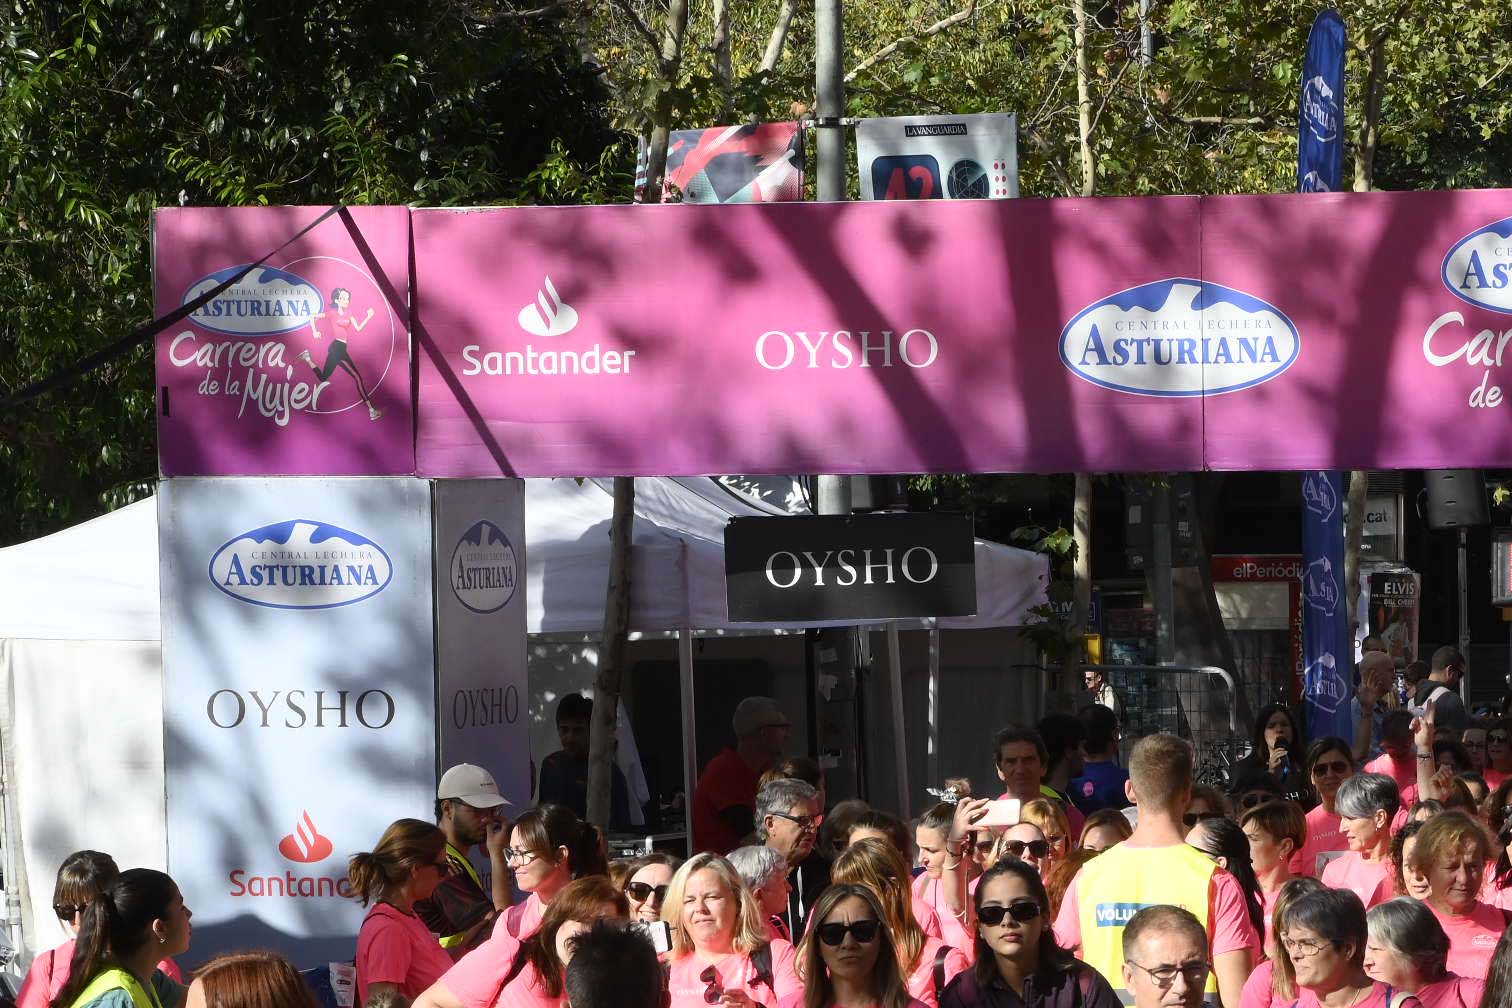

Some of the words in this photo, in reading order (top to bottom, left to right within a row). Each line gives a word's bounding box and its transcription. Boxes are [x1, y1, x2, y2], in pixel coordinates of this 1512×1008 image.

[1115, 320, 1190, 331] CENTRAL
[1197, 319, 1273, 330] LECHERA
[169, 331, 287, 368] Carrera
[462, 344, 636, 377] Santander
[755, 329, 939, 371] OYSHO
[1078, 323, 1281, 366] ASTURIANA
[198, 370, 219, 395] de
[226, 367, 240, 395] la
[238, 365, 331, 426] Mujer
[1469, 369, 1504, 409] de
[224, 553, 379, 587] ASTURIANA
[251, 551, 309, 560] CENTRAL
[315, 551, 373, 560] LECHERA
[456, 554, 514, 591] ASTURIANA
[765, 546, 939, 589] OYSHO
[1384, 582, 1415, 595] ELVIS
[206, 689, 396, 729] OYSHO
[453, 684, 519, 730] OYSHO
[229, 870, 350, 897] Santan
[1097, 909, 1137, 921] VOLU
